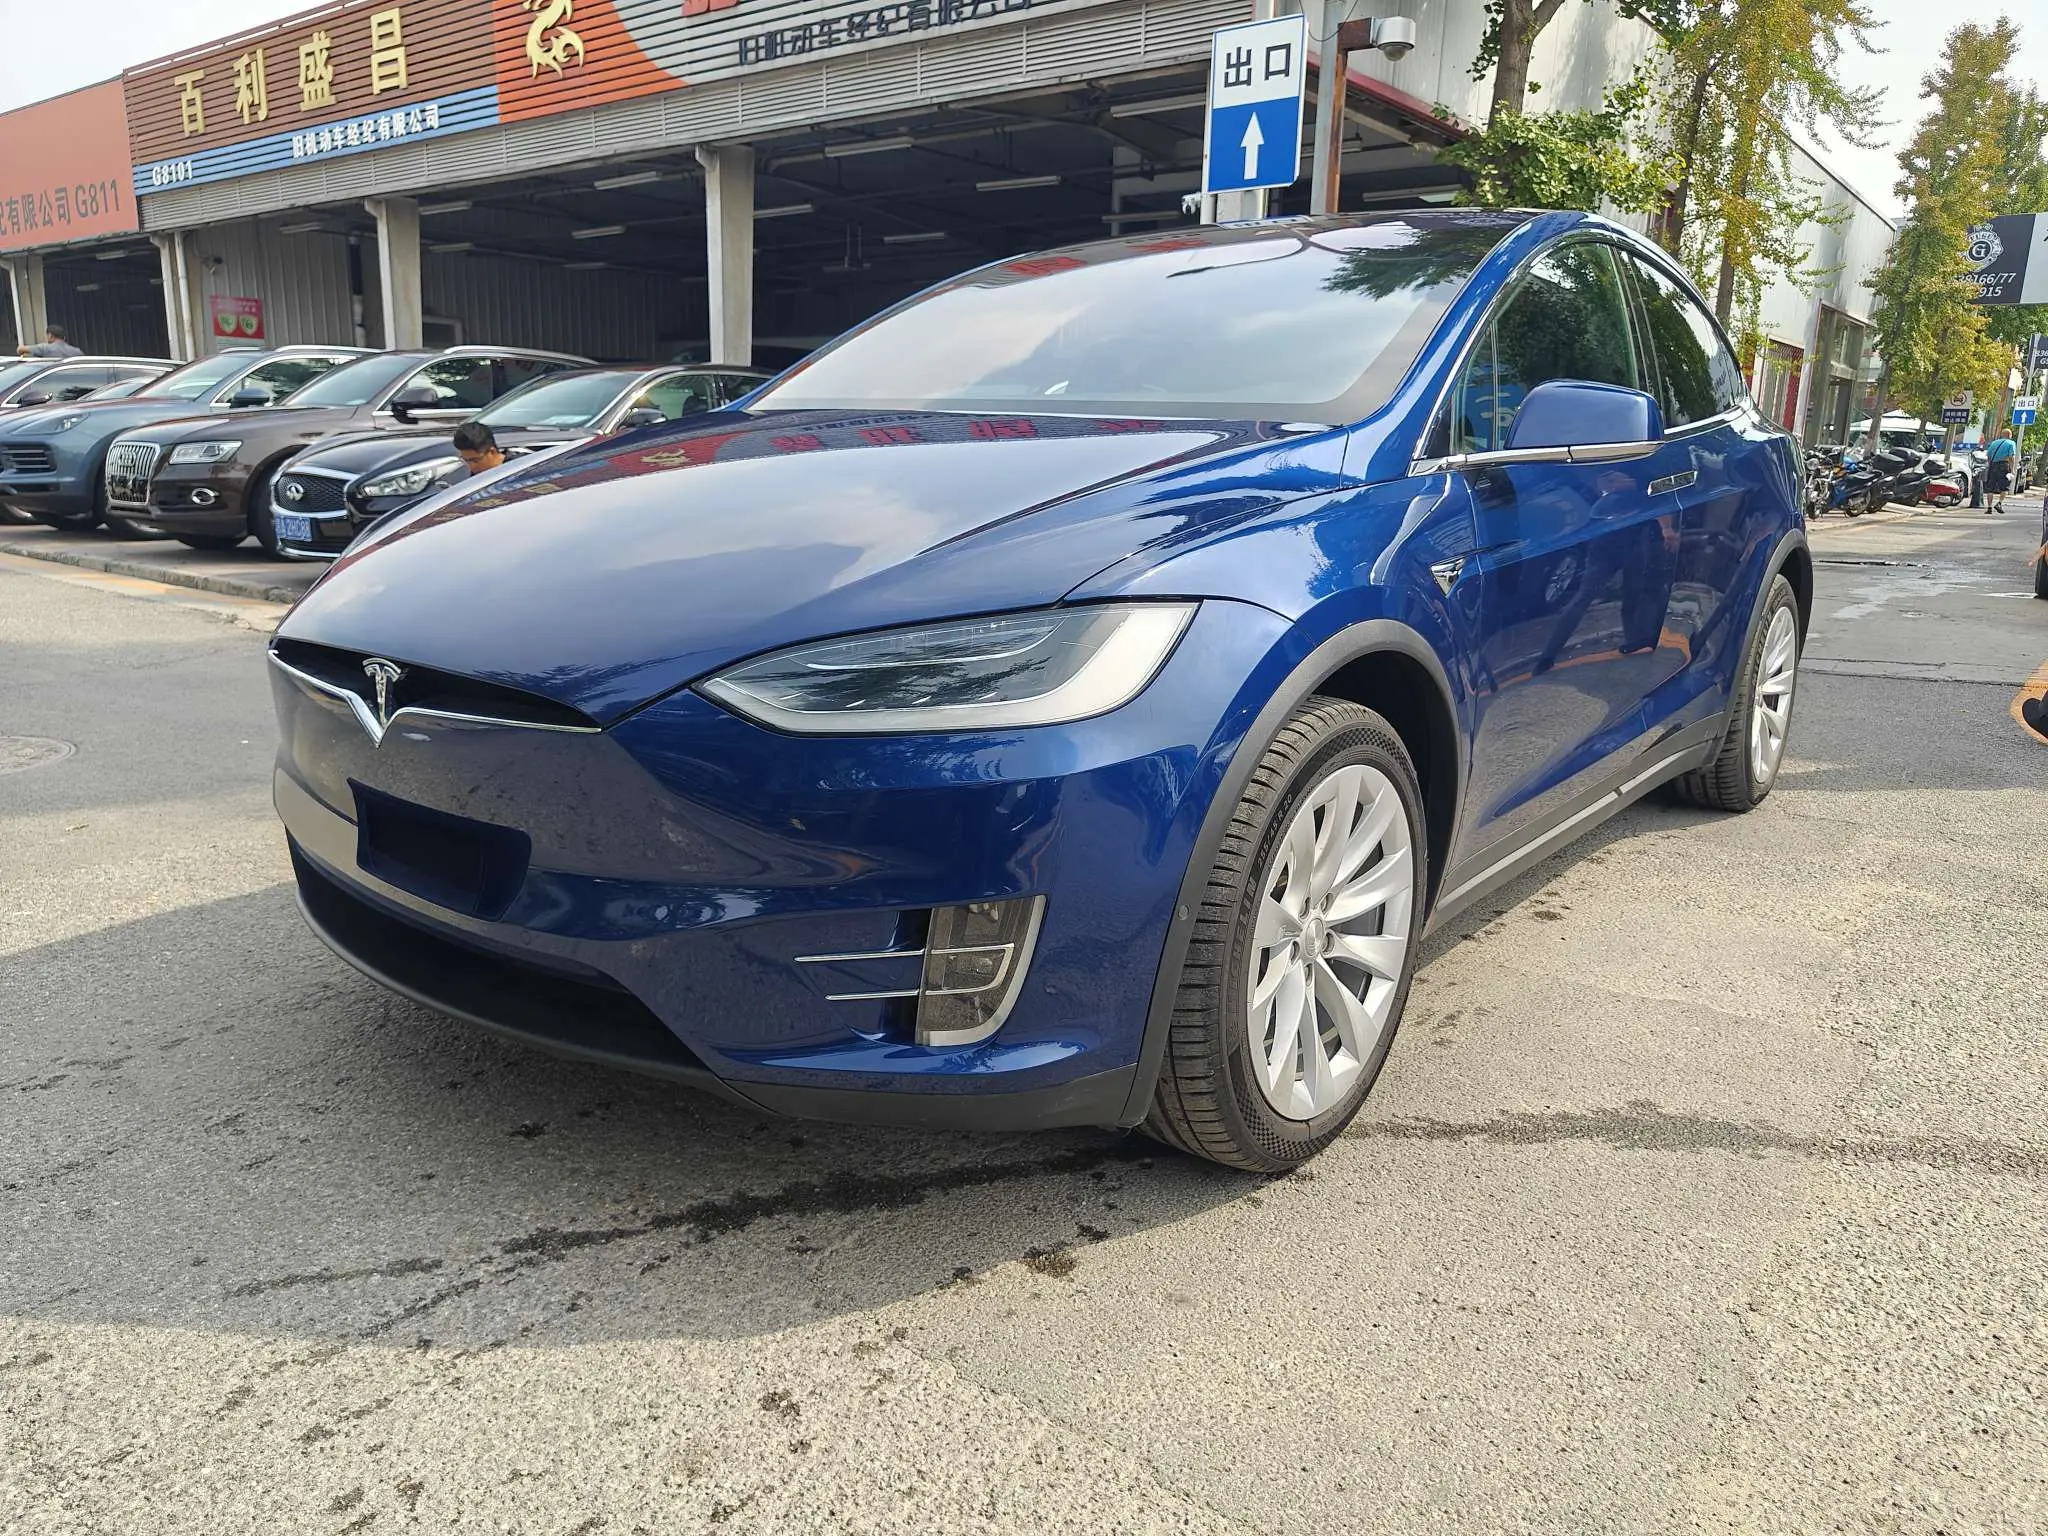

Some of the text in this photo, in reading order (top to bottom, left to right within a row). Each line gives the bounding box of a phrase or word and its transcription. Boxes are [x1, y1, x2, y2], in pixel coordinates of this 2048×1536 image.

[173, 6, 408, 138] 百利盛昌
[1223, 42, 1292, 89] 出口
[291, 103, 440, 159] 旧机动车经纪有限公司
[152, 160, 194, 187] G8101
[75, 178, 120, 218] G811
[2018, 400, 2035, 408] 出口
